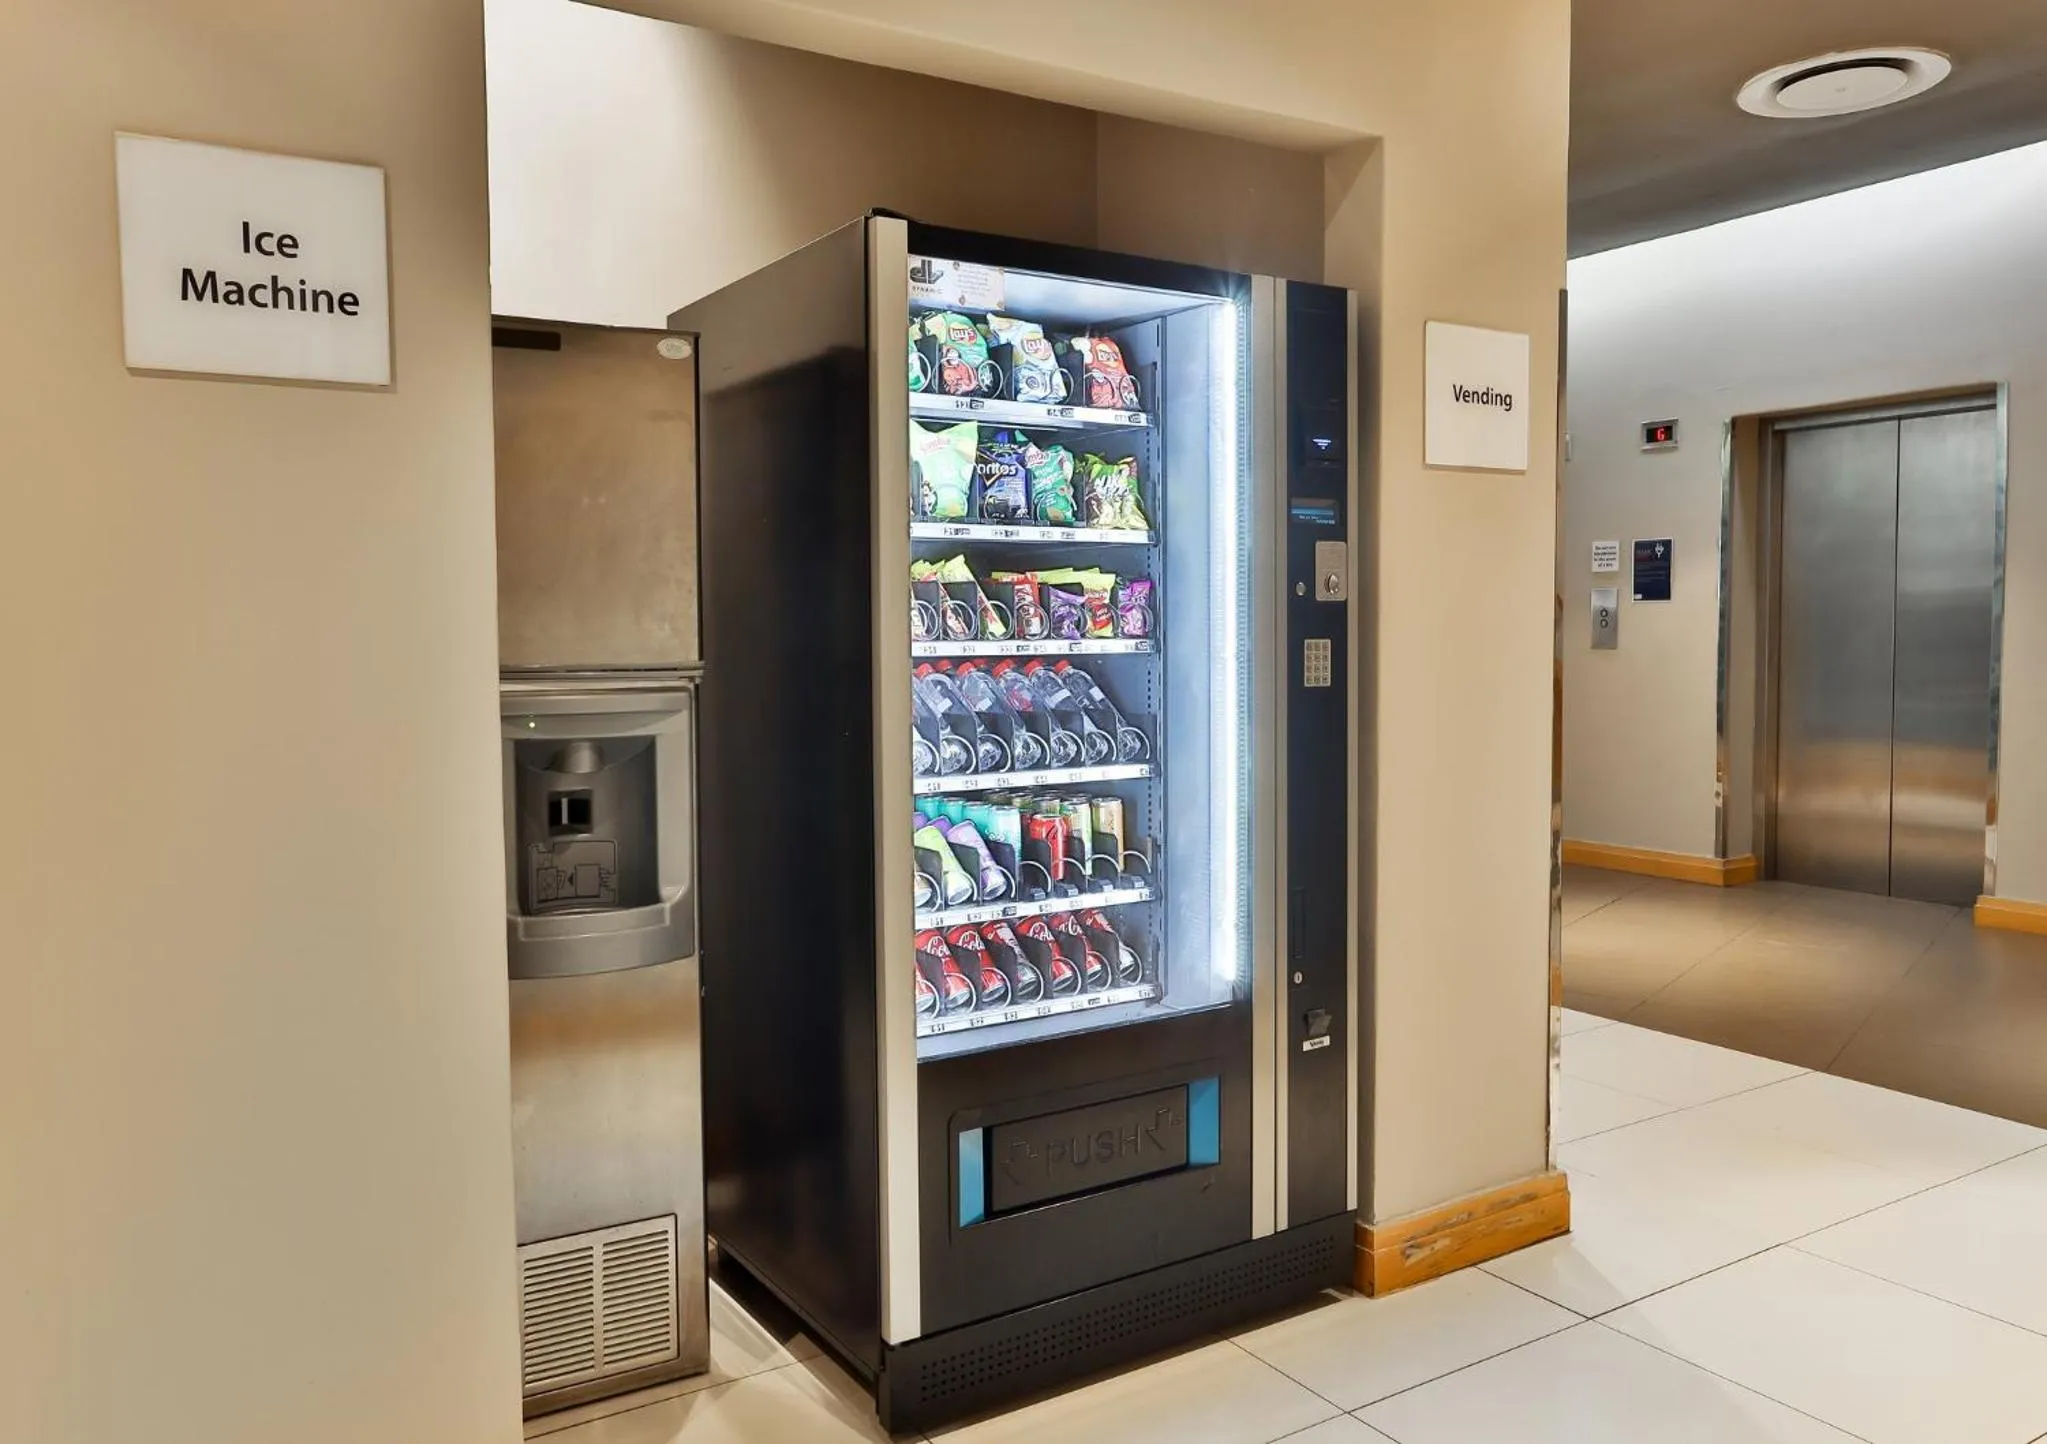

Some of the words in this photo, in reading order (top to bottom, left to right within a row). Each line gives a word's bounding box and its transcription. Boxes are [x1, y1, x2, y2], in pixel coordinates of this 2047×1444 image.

[242, 220, 300, 259] Ice
[180, 267, 360, 317] Machine
[1452, 384, 1513, 412] Vending
[973, 462, 1017, 475] oritos
[1046, 1123, 1142, 1177] PUSH
